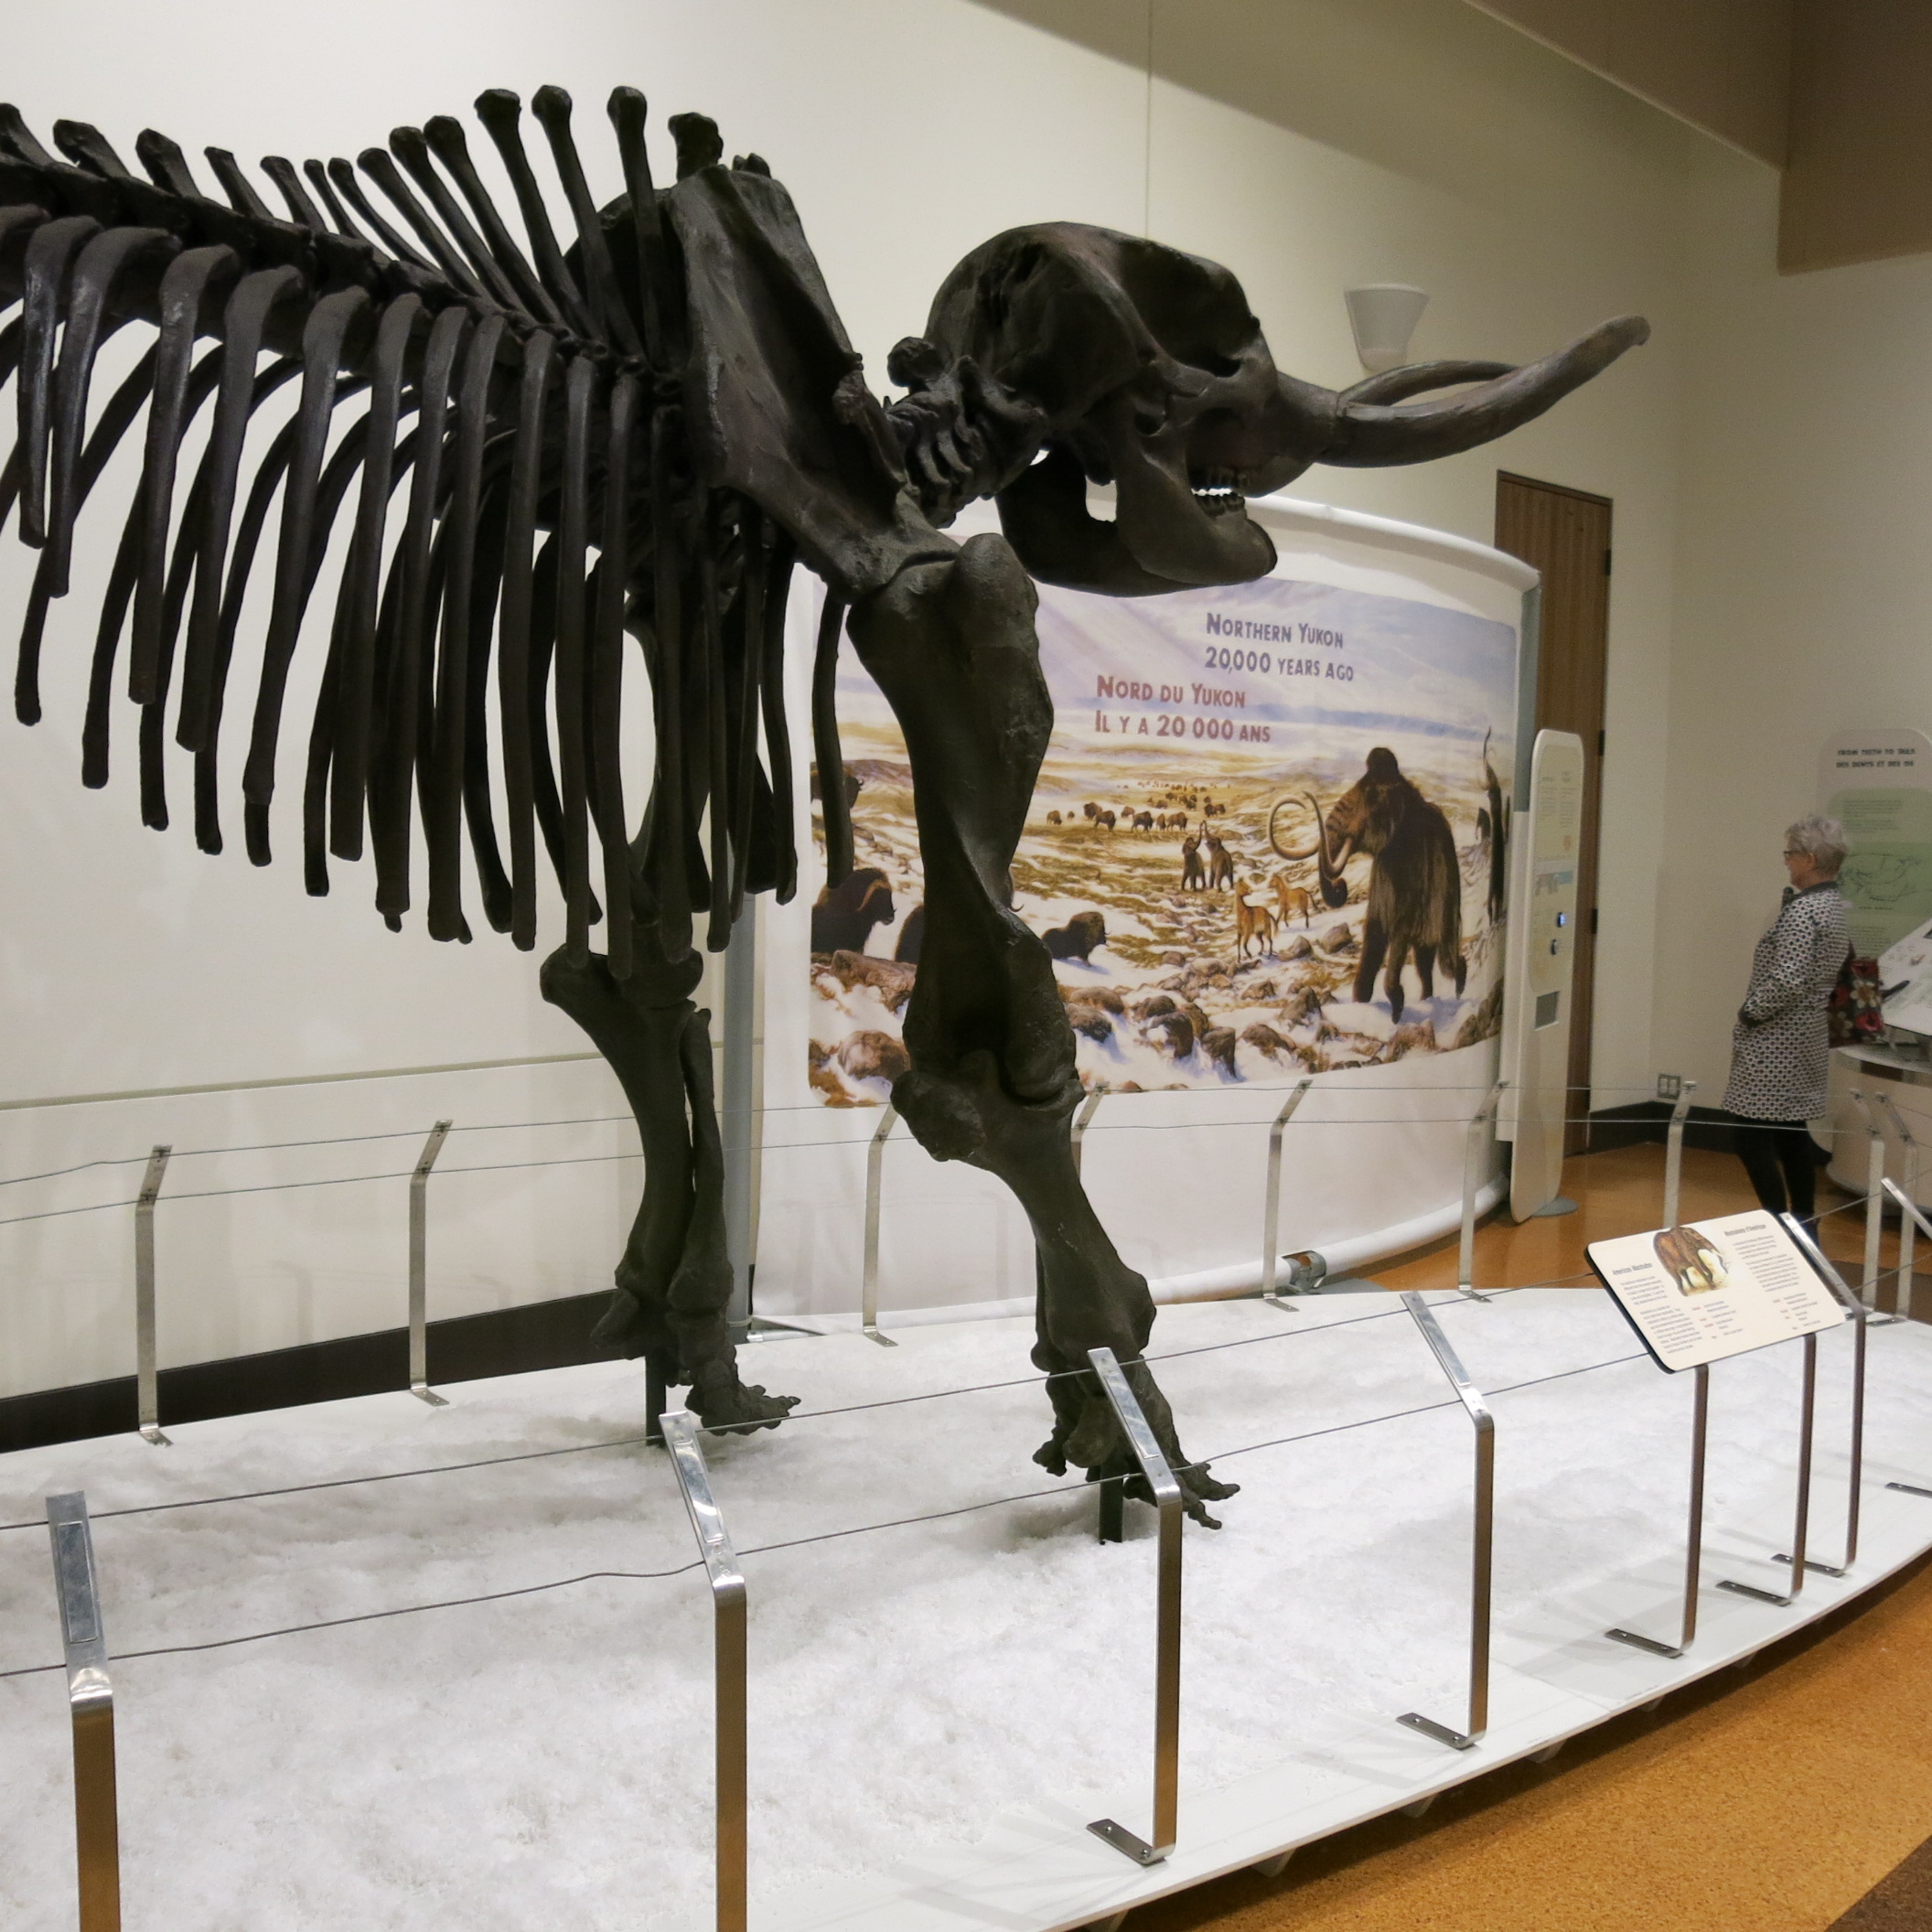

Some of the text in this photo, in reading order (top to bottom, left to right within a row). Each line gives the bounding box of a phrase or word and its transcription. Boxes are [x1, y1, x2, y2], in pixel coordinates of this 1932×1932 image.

[1206, 612, 1344, 649] NORTHERN YUKON
[1205, 647, 1354, 682] 20,000 YEARS AGO
[1097, 674, 1245, 708] NORD DU YUKON
[1096, 710, 1271, 743] IL Y A 20 000 ANS
